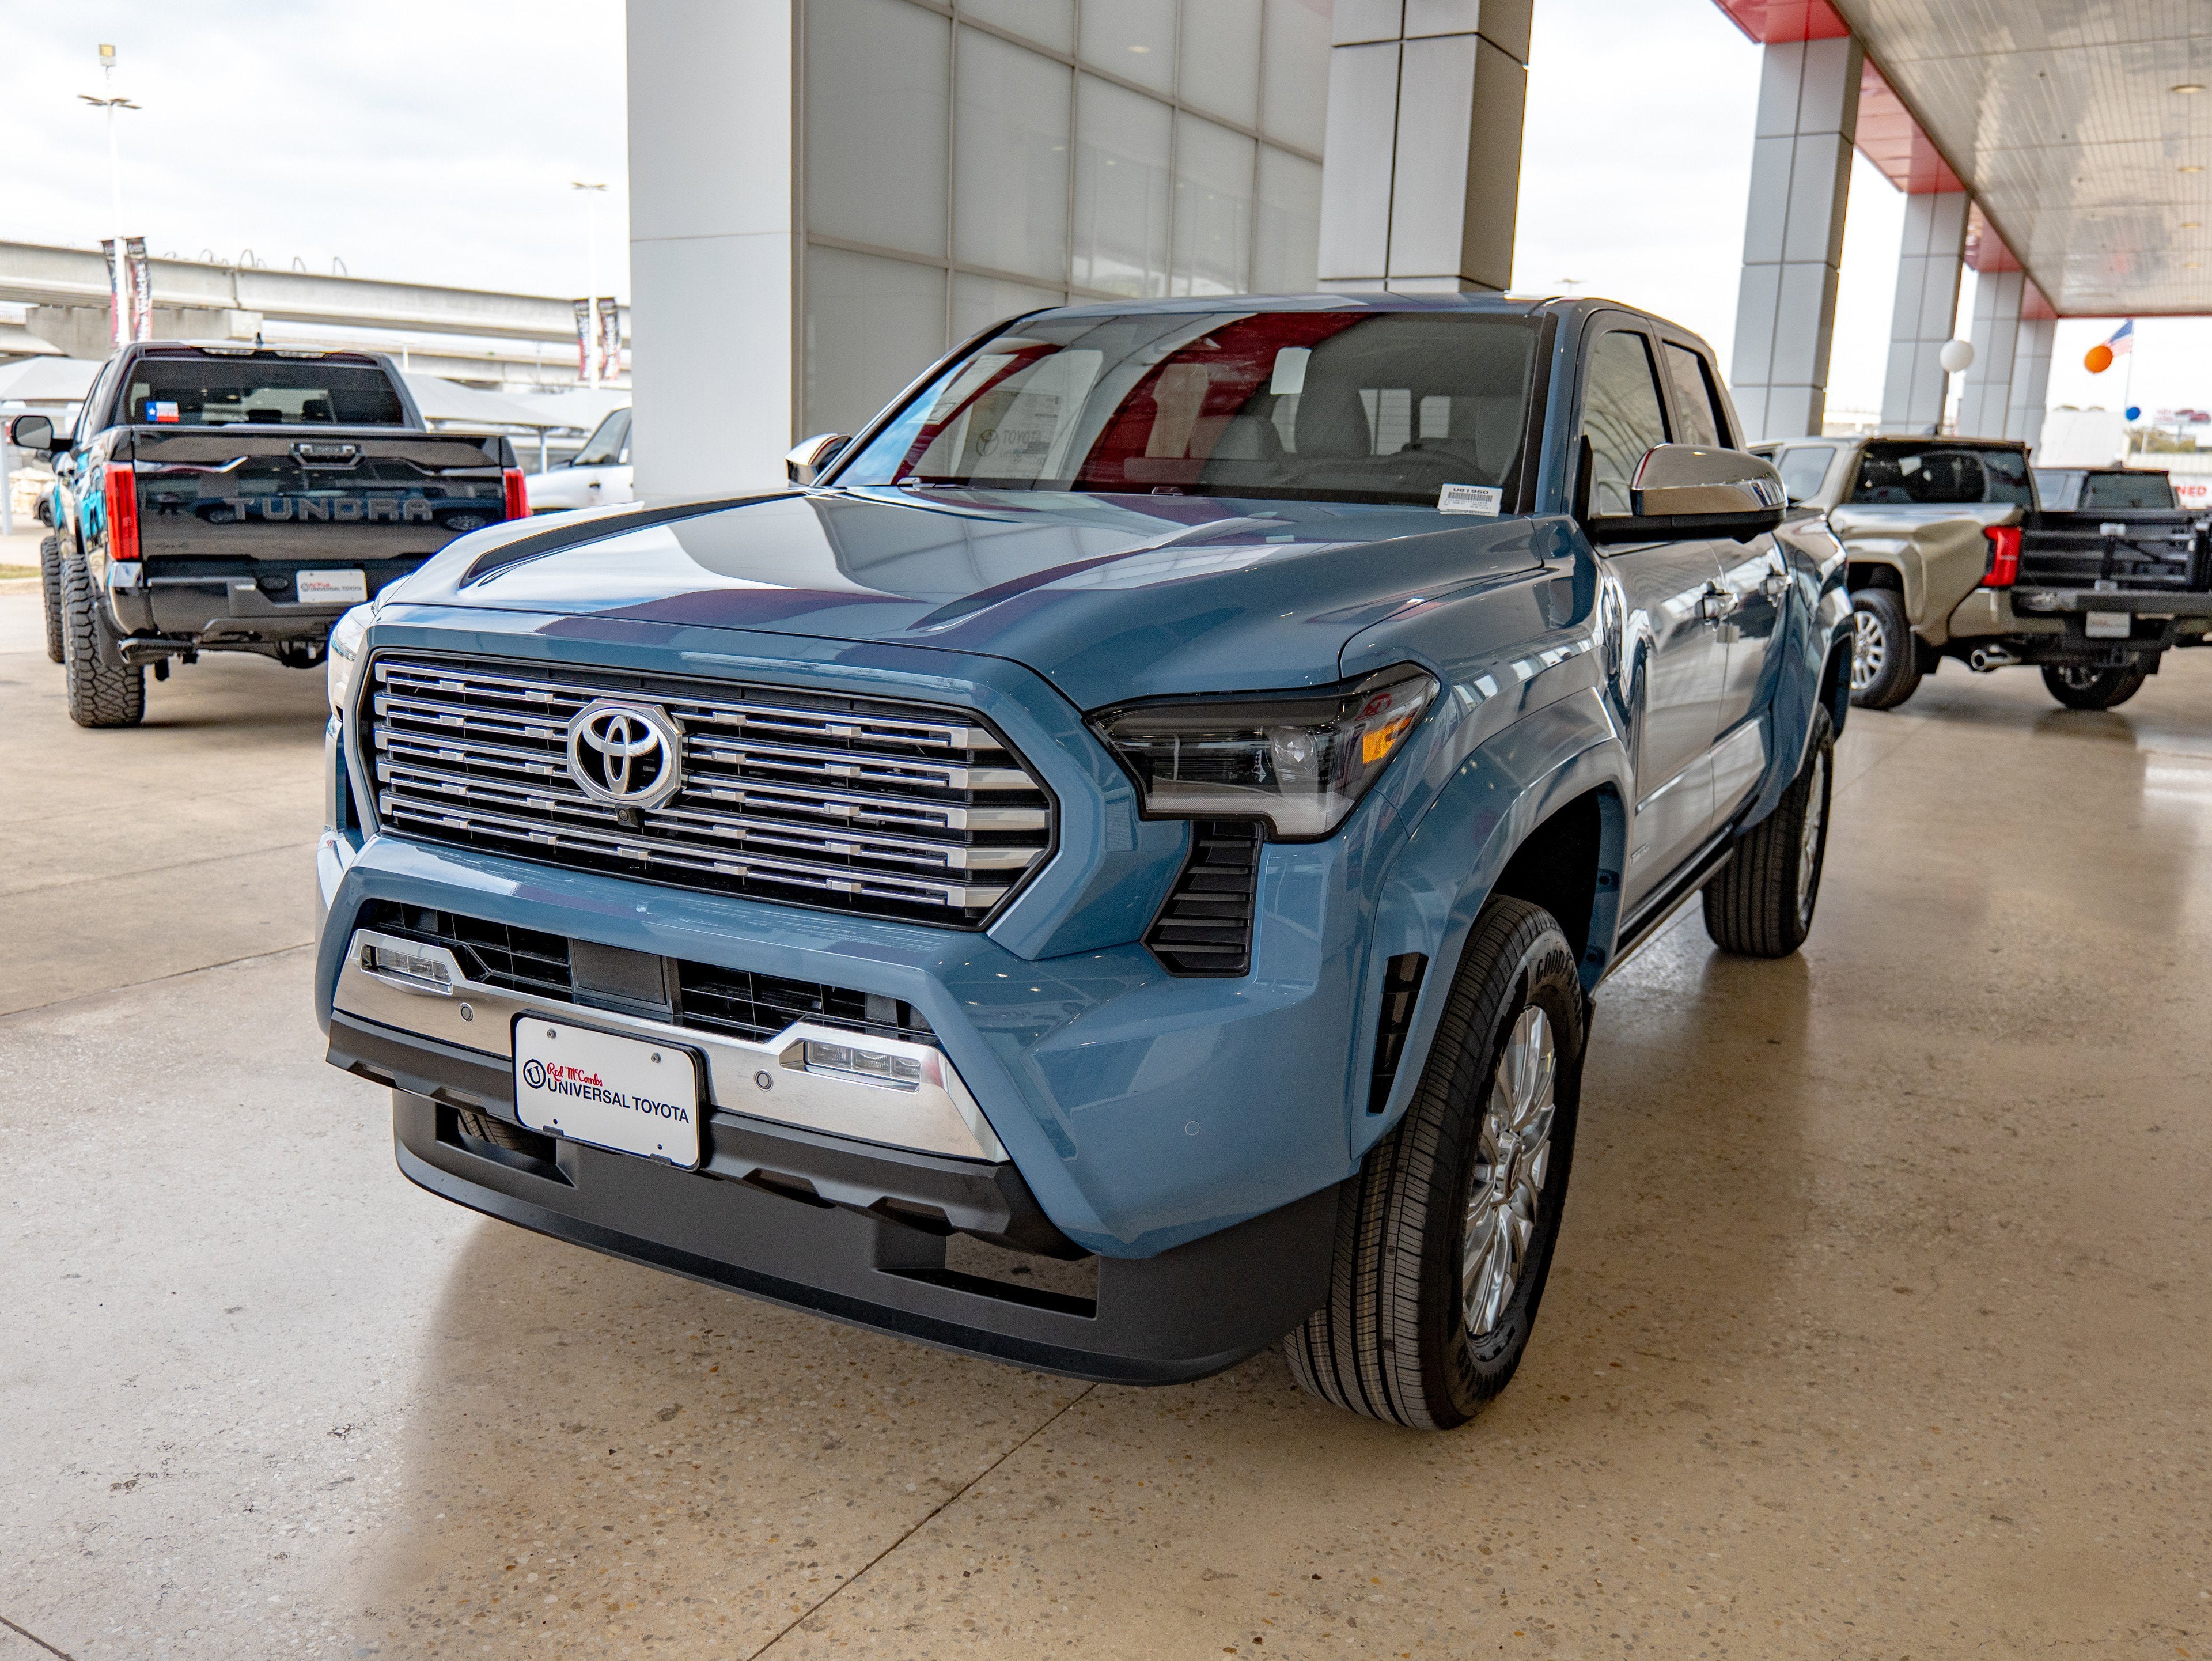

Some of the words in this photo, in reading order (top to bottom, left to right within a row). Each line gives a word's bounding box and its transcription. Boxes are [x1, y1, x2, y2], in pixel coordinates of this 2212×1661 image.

[224, 498, 433, 520] TUNDRA
[547, 1062, 564, 1082] Red
[565, 1066, 603, 1087] McCombs
[547, 1077, 631, 1110] UNIVERSAL
[632, 1096, 690, 1124] TOYOTA
